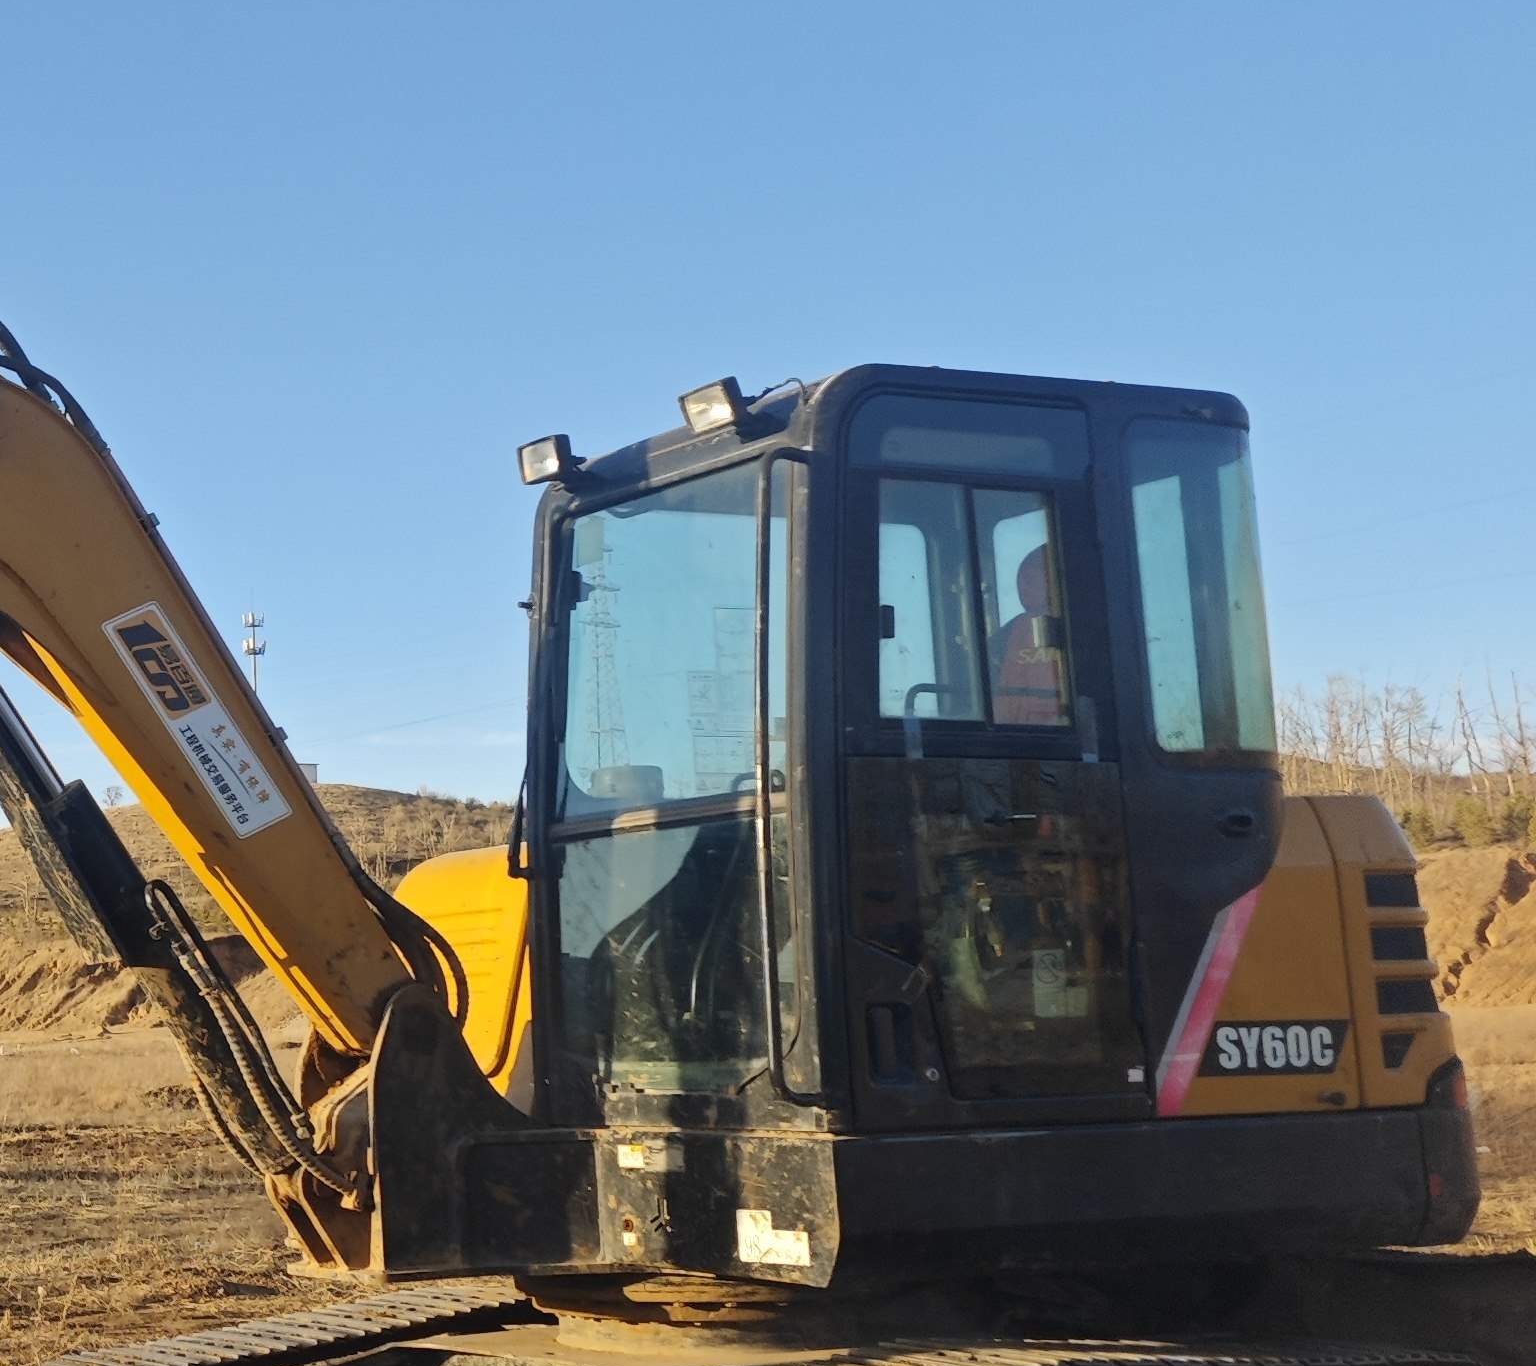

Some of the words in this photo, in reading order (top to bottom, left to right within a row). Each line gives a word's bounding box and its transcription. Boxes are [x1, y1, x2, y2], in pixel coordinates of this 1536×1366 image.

[179, 723, 249, 825] 工程机械交易服务平台
[1216, 1025, 1334, 1069] SY60C
